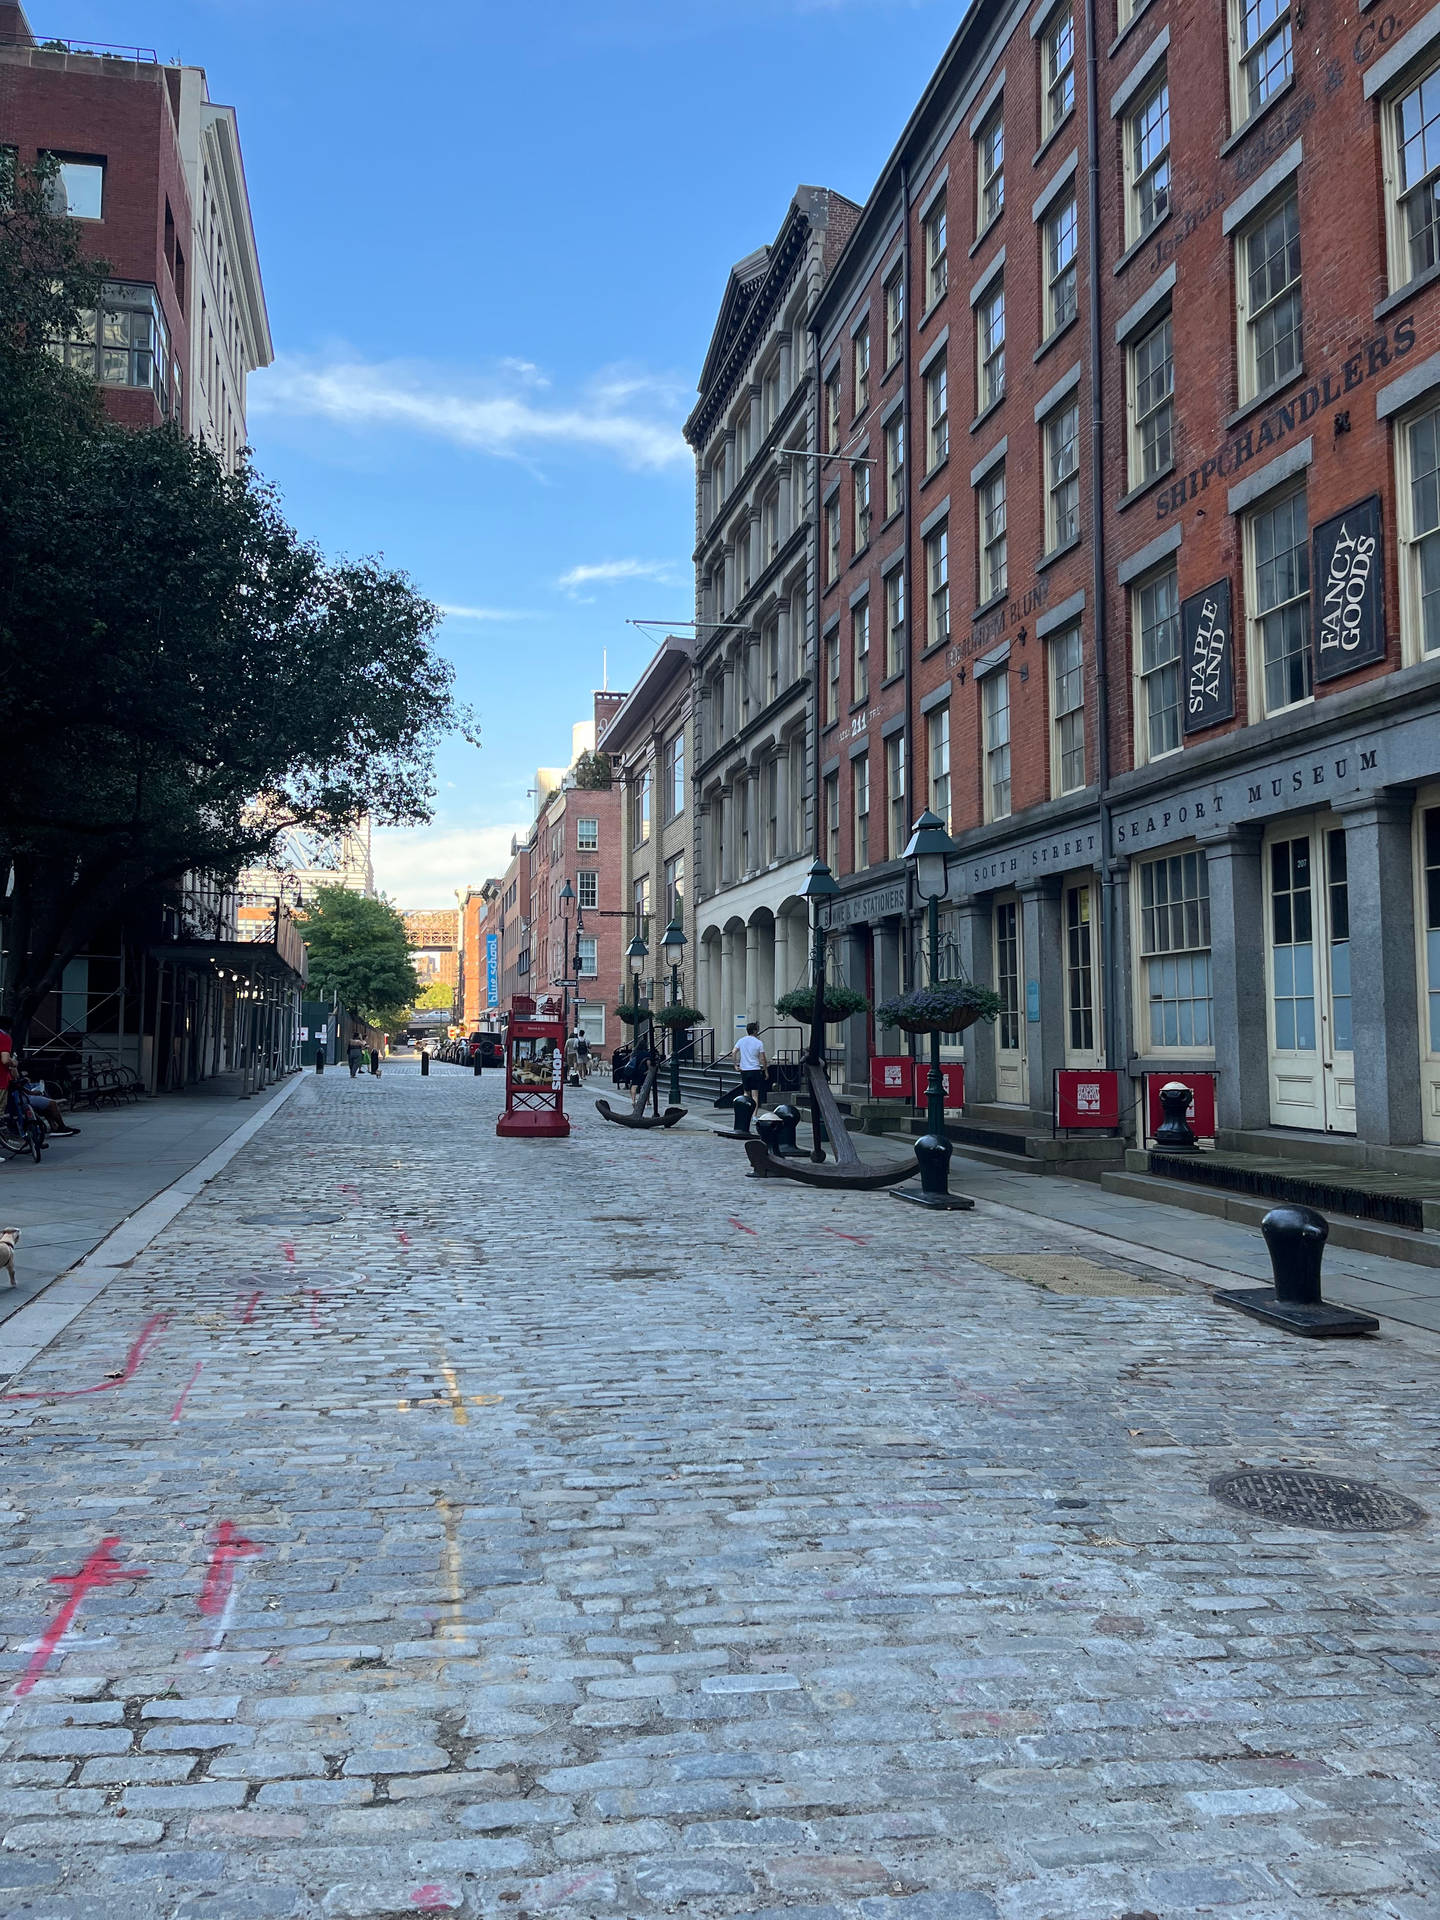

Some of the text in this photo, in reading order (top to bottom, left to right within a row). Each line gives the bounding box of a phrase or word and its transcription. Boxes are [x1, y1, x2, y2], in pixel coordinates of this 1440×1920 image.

[1353, 14, 1403, 65] Co.
[1320, 522, 1358, 653] FANCY
[1341, 535, 1376, 651] GOODS
[1189, 598, 1218, 714] STAPLE
[1205, 628, 1225, 701] AND
[851, 712, 867, 737] 211
[974, 750, 1377, 883] SOUTH STREET SEAPORT MUSEUM
[824, 904, 845, 926] BWNE
[487, 939, 498, 1003] blue school
[551, 1048, 563, 1091] SHOP
